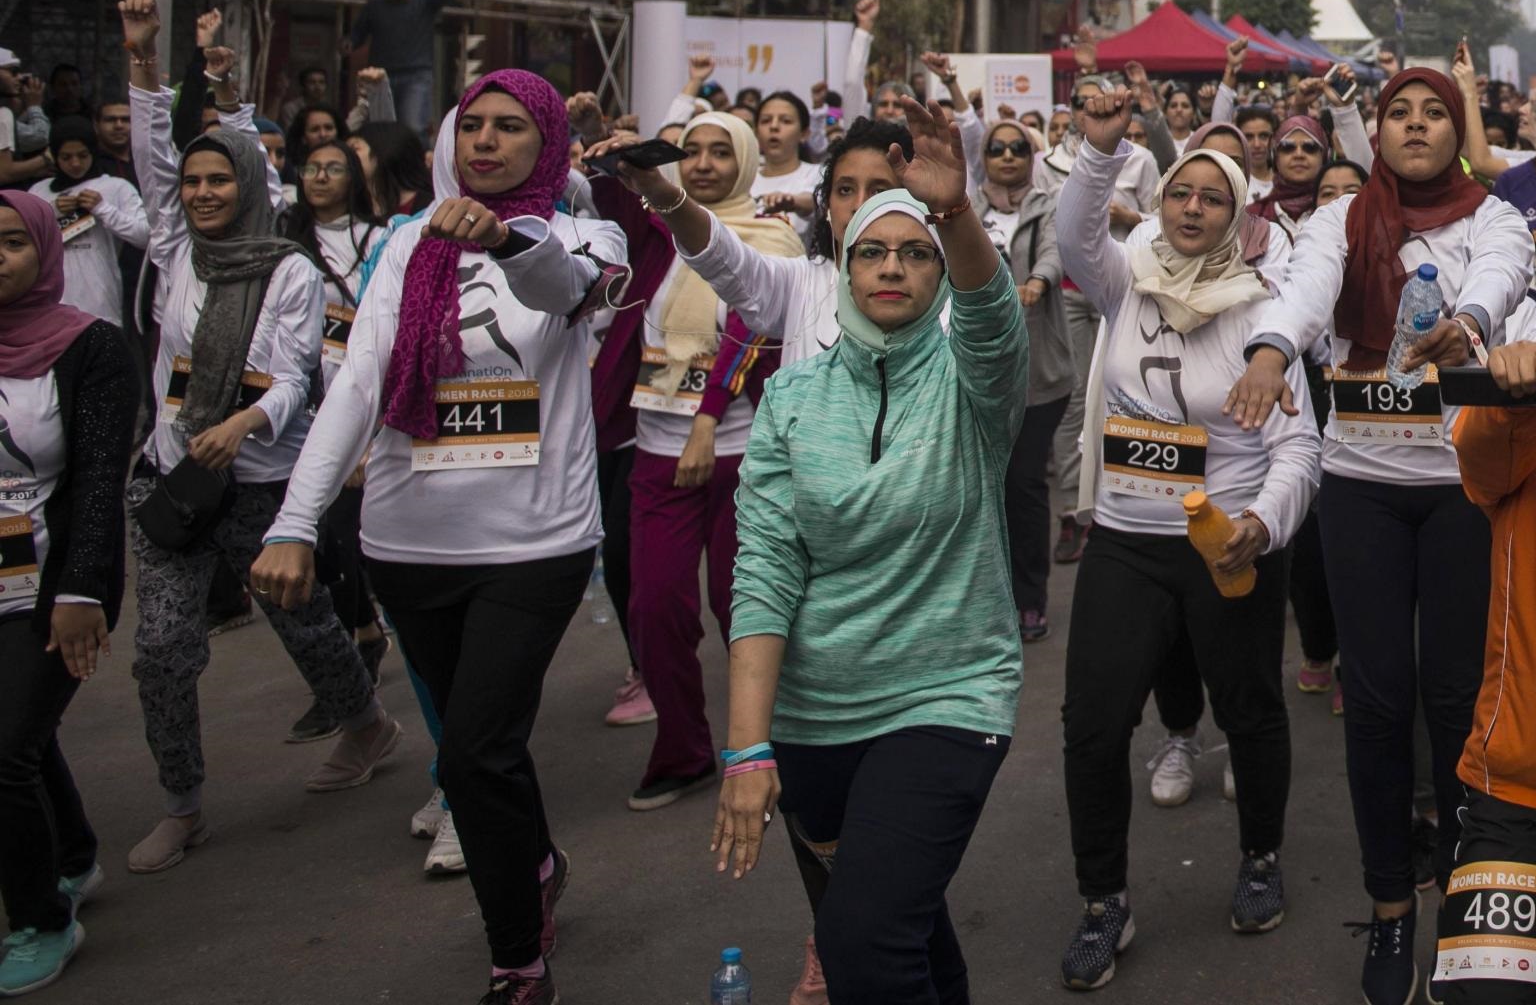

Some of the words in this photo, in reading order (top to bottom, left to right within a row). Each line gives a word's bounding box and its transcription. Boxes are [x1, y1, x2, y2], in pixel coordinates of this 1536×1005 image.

[471, 389, 505, 399] RACE
[508, 387, 534, 398] 2018
[1361, 383, 1413, 412] 193
[443, 403, 502, 433] 441
[1109, 424, 1149, 437] WOMEN
[1151, 429, 1180, 441] RACE
[1181, 435, 1204, 444] 2018
[1127, 440, 1179, 471] 229
[1451, 873, 1492, 890] WOMEN
[1496, 873, 1535, 888] RACE
[1464, 892, 1536, 932] 489
